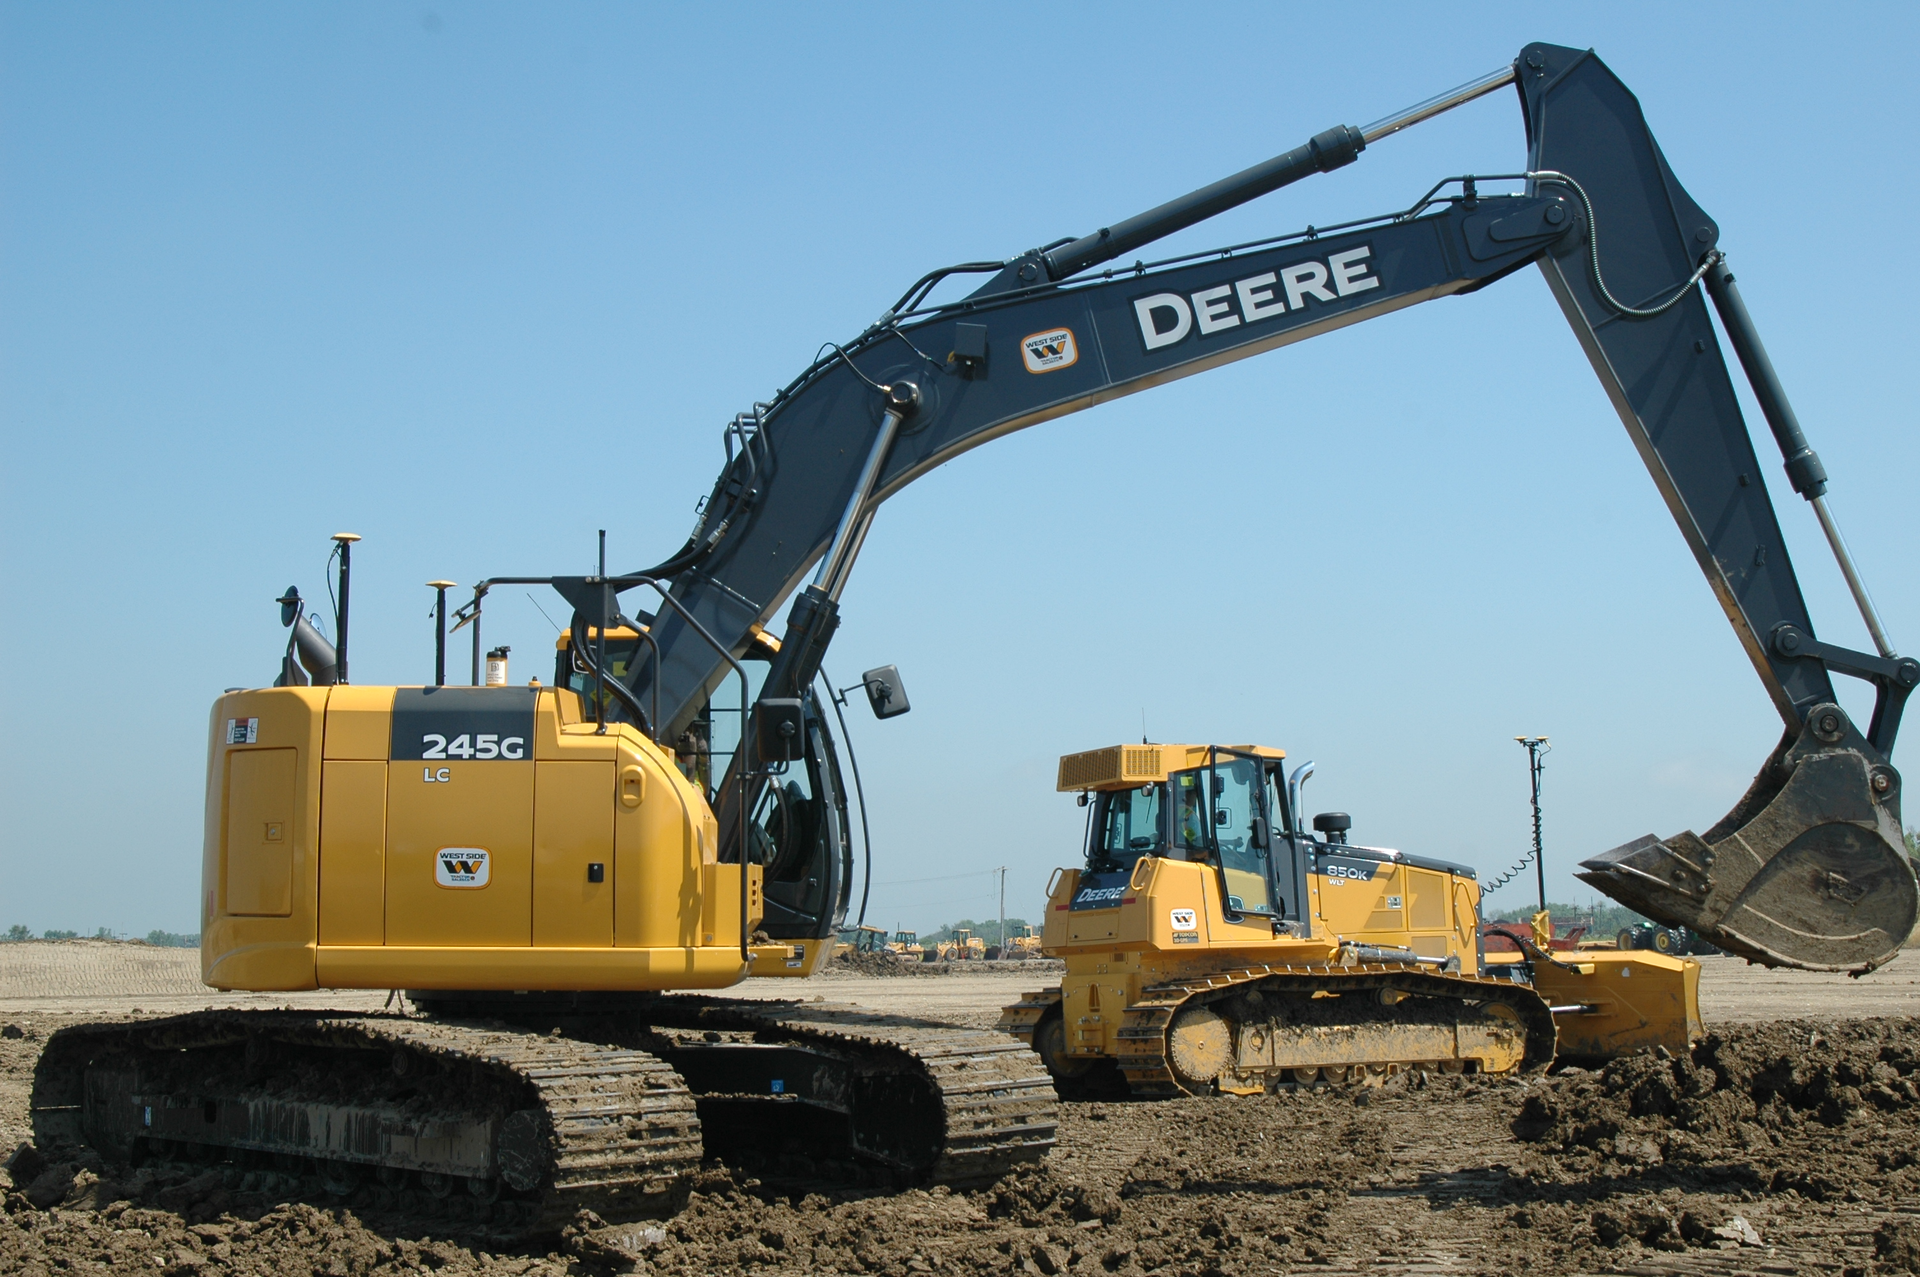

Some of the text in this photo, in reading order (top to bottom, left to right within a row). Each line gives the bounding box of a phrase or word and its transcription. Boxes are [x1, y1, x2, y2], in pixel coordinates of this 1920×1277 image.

[1133, 245, 1380, 351] DEERE
[1025, 333, 1068, 348] WEST SIDE
[422, 733, 524, 760] 245G
[423, 767, 450, 783] LC
[1326, 864, 1368, 881] 850K
[1328, 878, 1345, 886] WLT
[1076, 886, 1125, 903] DEERE
